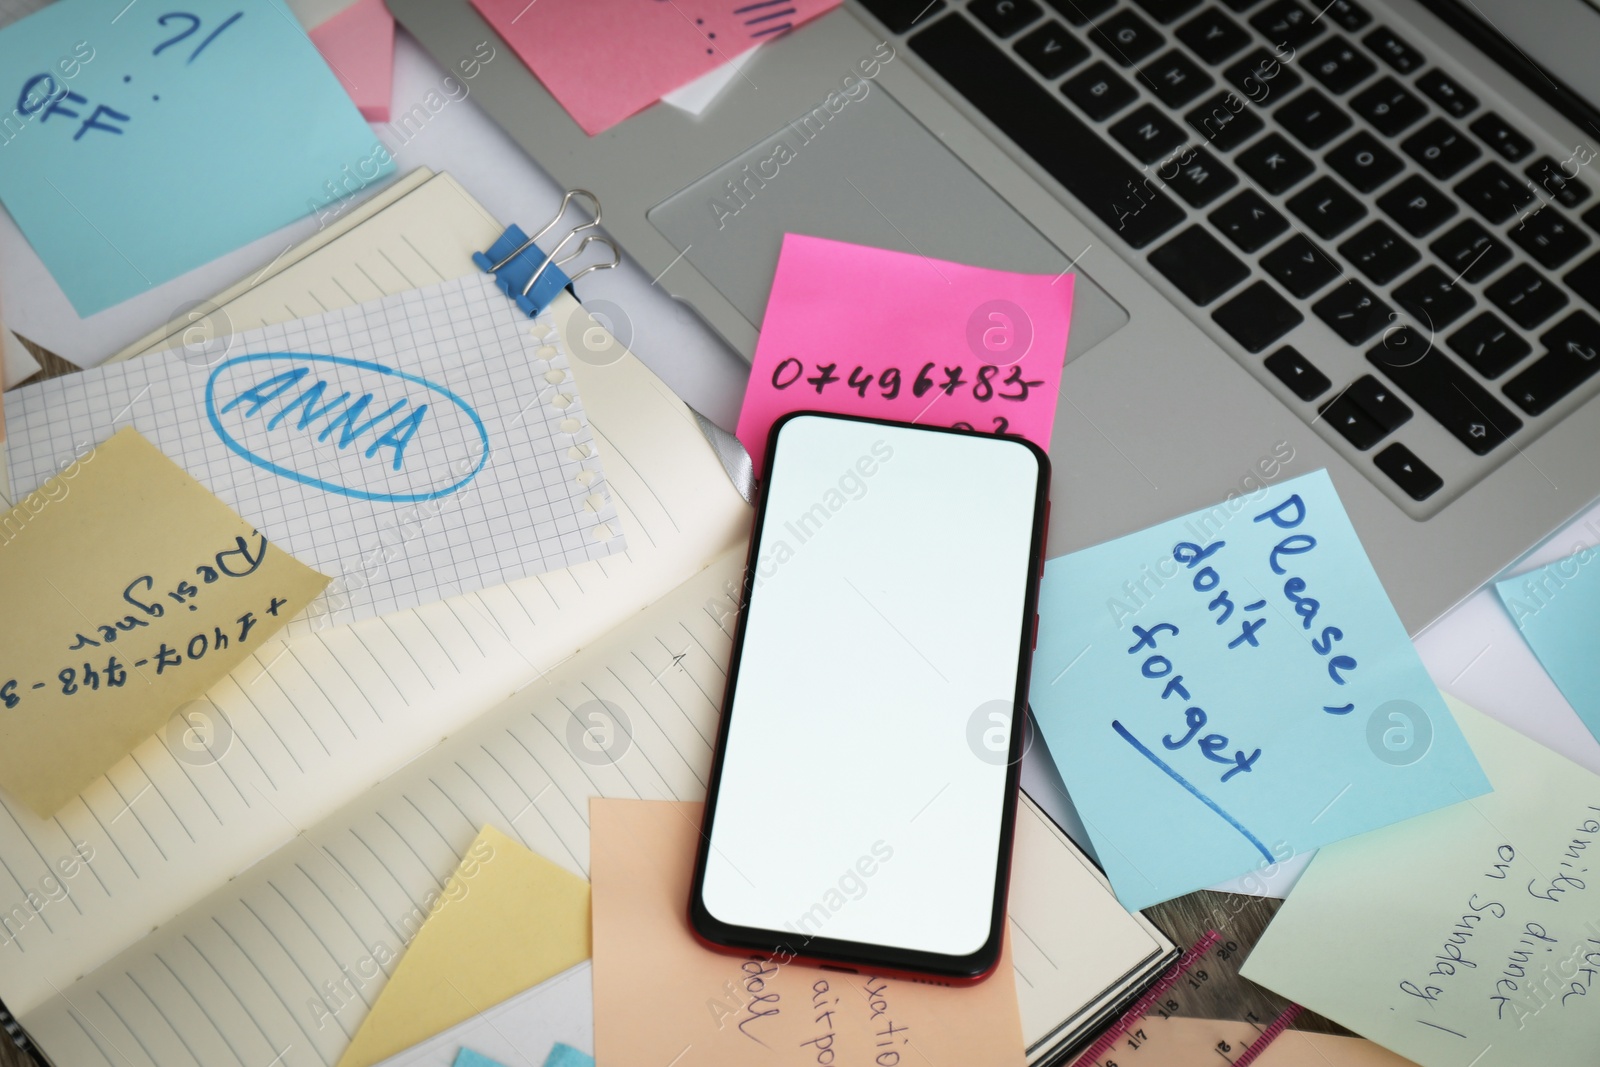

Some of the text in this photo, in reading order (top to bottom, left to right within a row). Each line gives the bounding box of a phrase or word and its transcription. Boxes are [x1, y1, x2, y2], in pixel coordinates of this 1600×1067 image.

[1117, 28, 1137, 44] G
[1206, 25, 1224, 41] Y
[1043, 38, 1062, 54] V
[1164, 68, 1186, 85] H
[1090, 81, 1109, 96] B
[1137, 122, 1160, 141] N
[1265, 153, 1286, 170] K
[1186, 166, 1210, 185] M
[1318, 198, 1333, 215] L
[1408, 197, 1428, 210] P
[221, 366, 428, 472] ANNA
[68, 530, 268, 651] Designer
[1173, 540, 1267, 650] don't
[1253, 493, 1358, 715] Please,
[1127, 622, 1262, 783] forget
[1484, 844, 1515, 880] on
[1489, 806, 1600, 1020] amily dinner
[1216, 940, 1239, 962] 20
[1188, 970, 1209, 990] 19
[1158, 999, 1180, 1020] 18
[1127, 1029, 1148, 1051] 17
